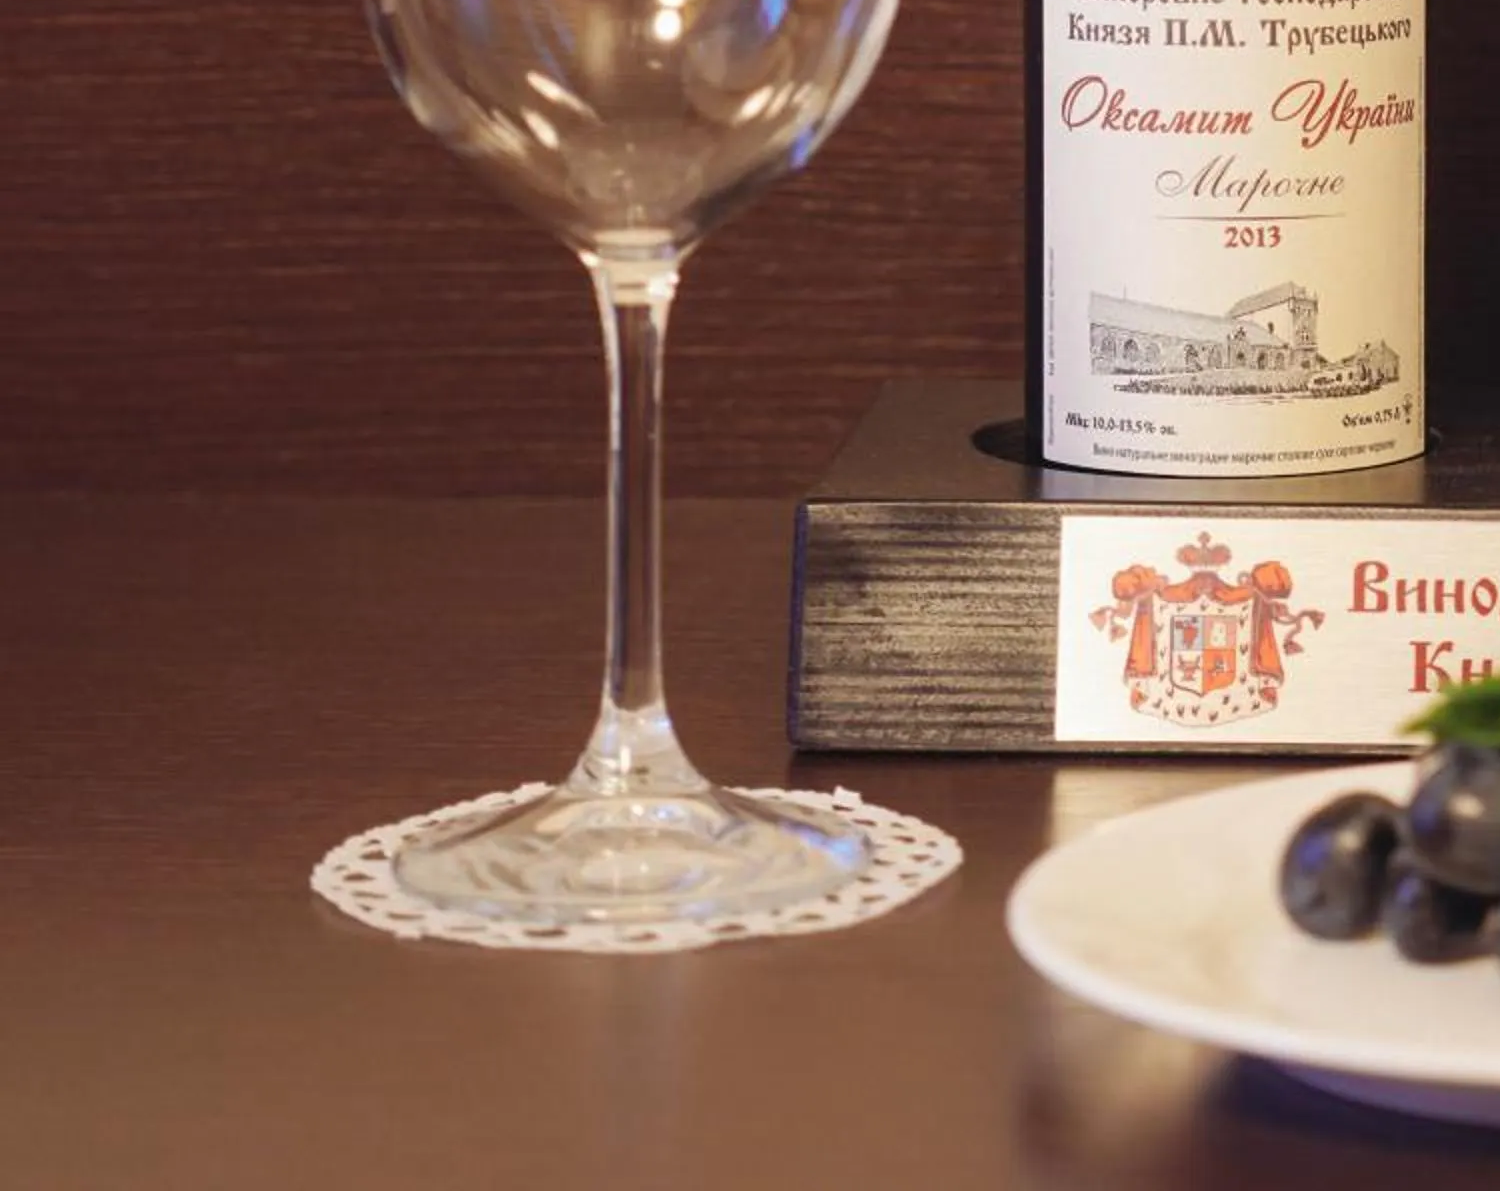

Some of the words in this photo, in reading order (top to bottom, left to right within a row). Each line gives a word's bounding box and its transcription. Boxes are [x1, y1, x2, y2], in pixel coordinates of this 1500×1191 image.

[1068, 12, 1151, 46] Князя
[1163, 18, 1247, 48] П.М.
[1259, 16, 1412, 56] Трубецького
[1061, 74, 1254, 136] Оксамит
[1271, 77, 1416, 149] України
[1154, 155, 1346, 213] Марочне
[1223, 224, 1282, 249] 2013
